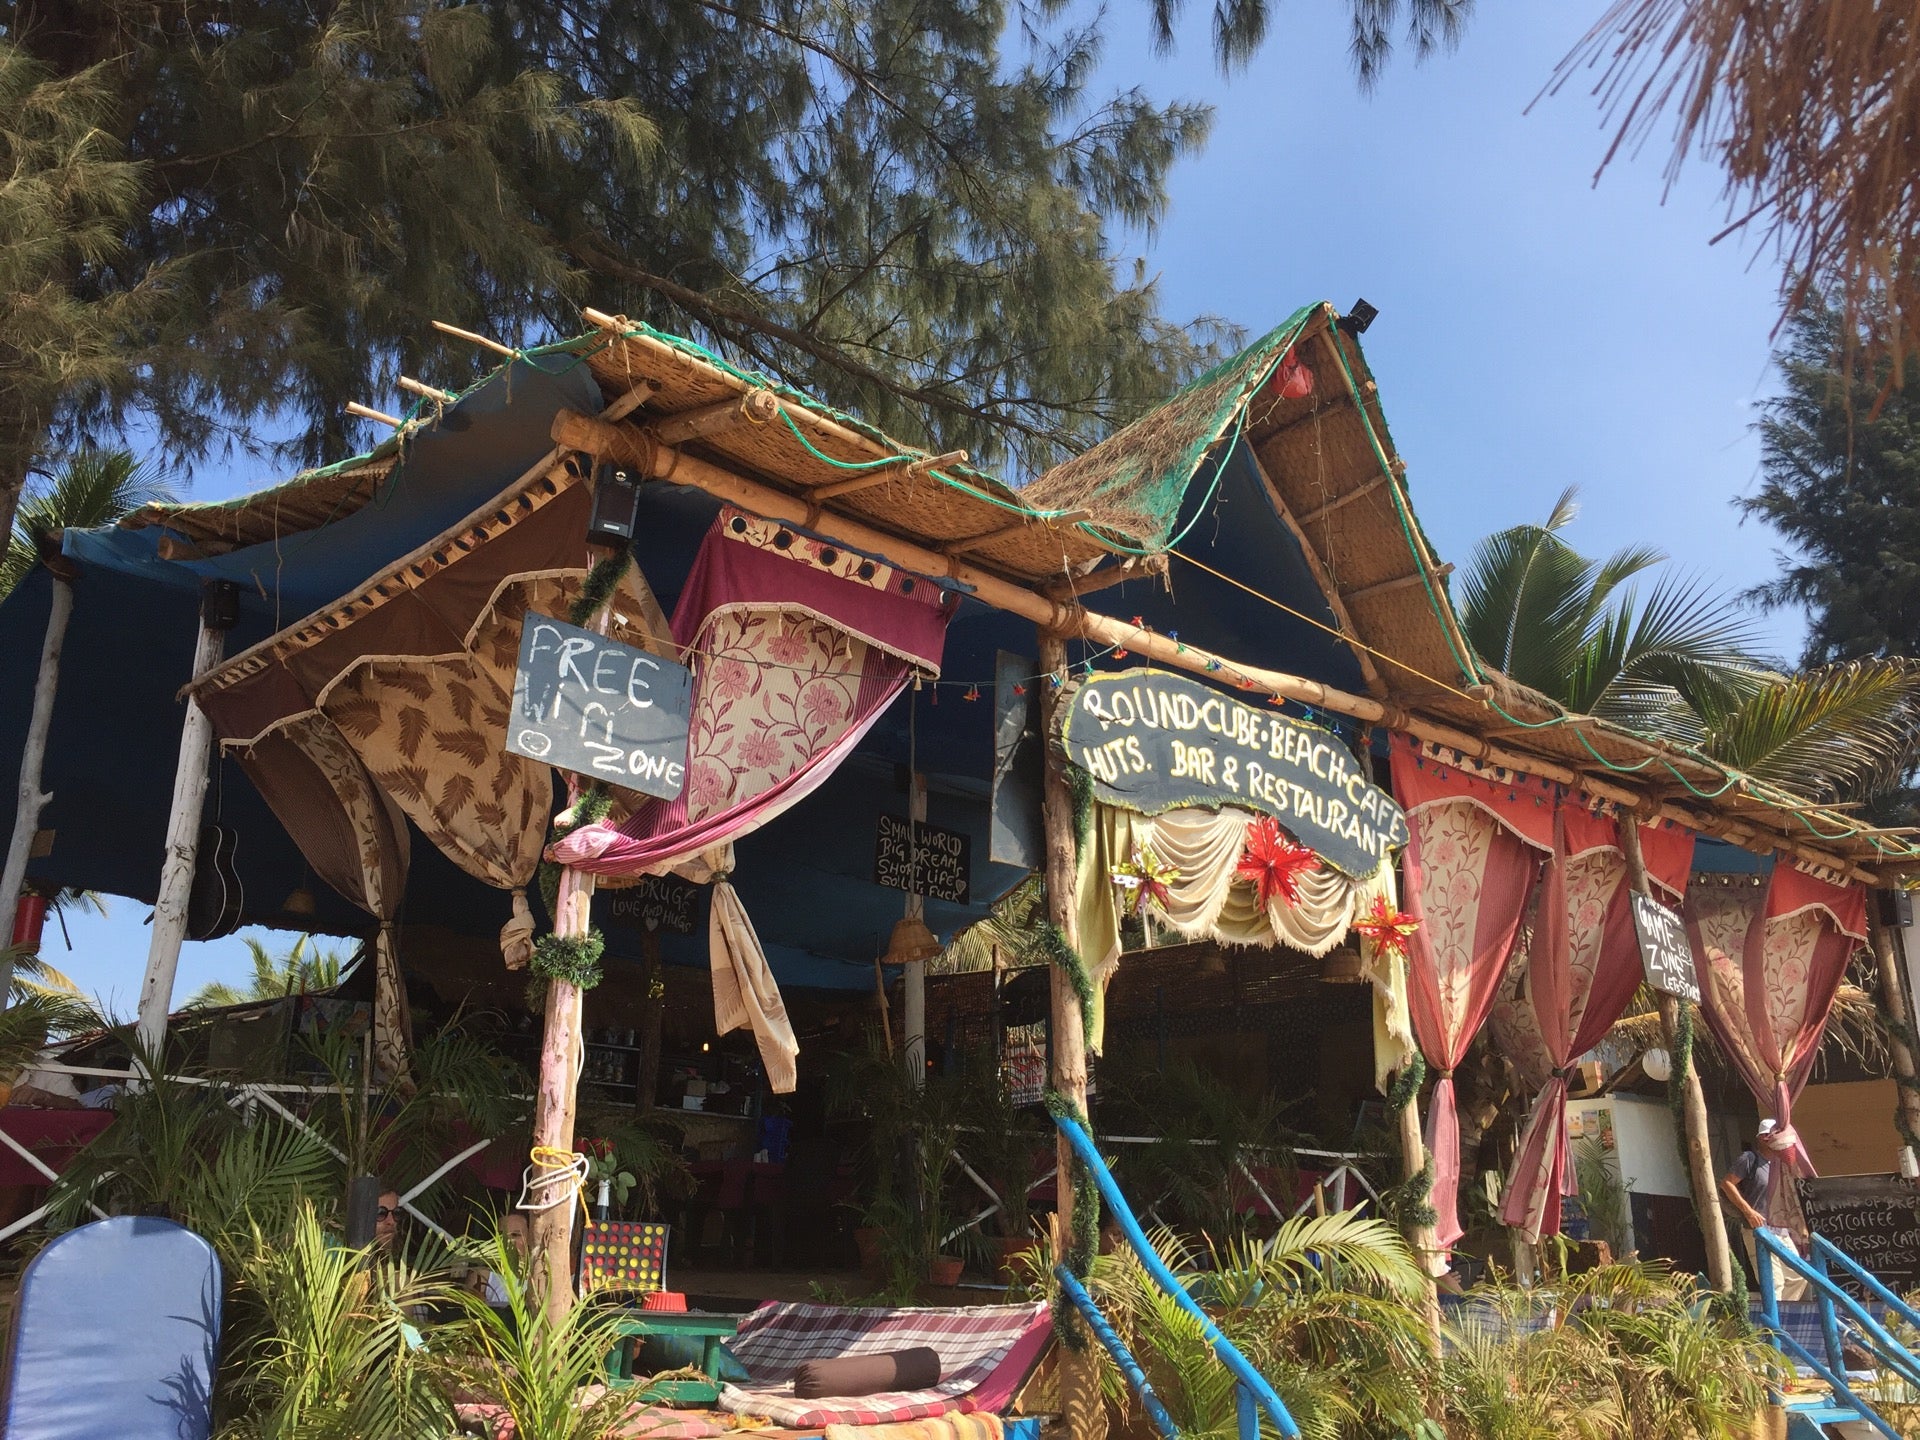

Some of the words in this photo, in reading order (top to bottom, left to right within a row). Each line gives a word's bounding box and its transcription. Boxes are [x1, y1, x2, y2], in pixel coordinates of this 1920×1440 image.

[529, 625, 660, 709] FREE
[583, 742, 685, 788] ZONE
[1170, 740, 1217, 785] BAR
[1222, 756, 1240, 793] &
[1246, 762, 1390, 858] RESTAURANT
[1346, 774, 1404, 842] CAFE
[879, 815, 918, 844] SMAL
[921, 829, 962, 857] WORLD
[911, 847, 964, 877] DREAMS
[613, 899, 640, 918] LOVE
[642, 904, 663, 918] AND
[929, 885, 960, 904] FUCK
[1638, 896, 1676, 952] GAME
[1646, 944, 1686, 981] ZONE
